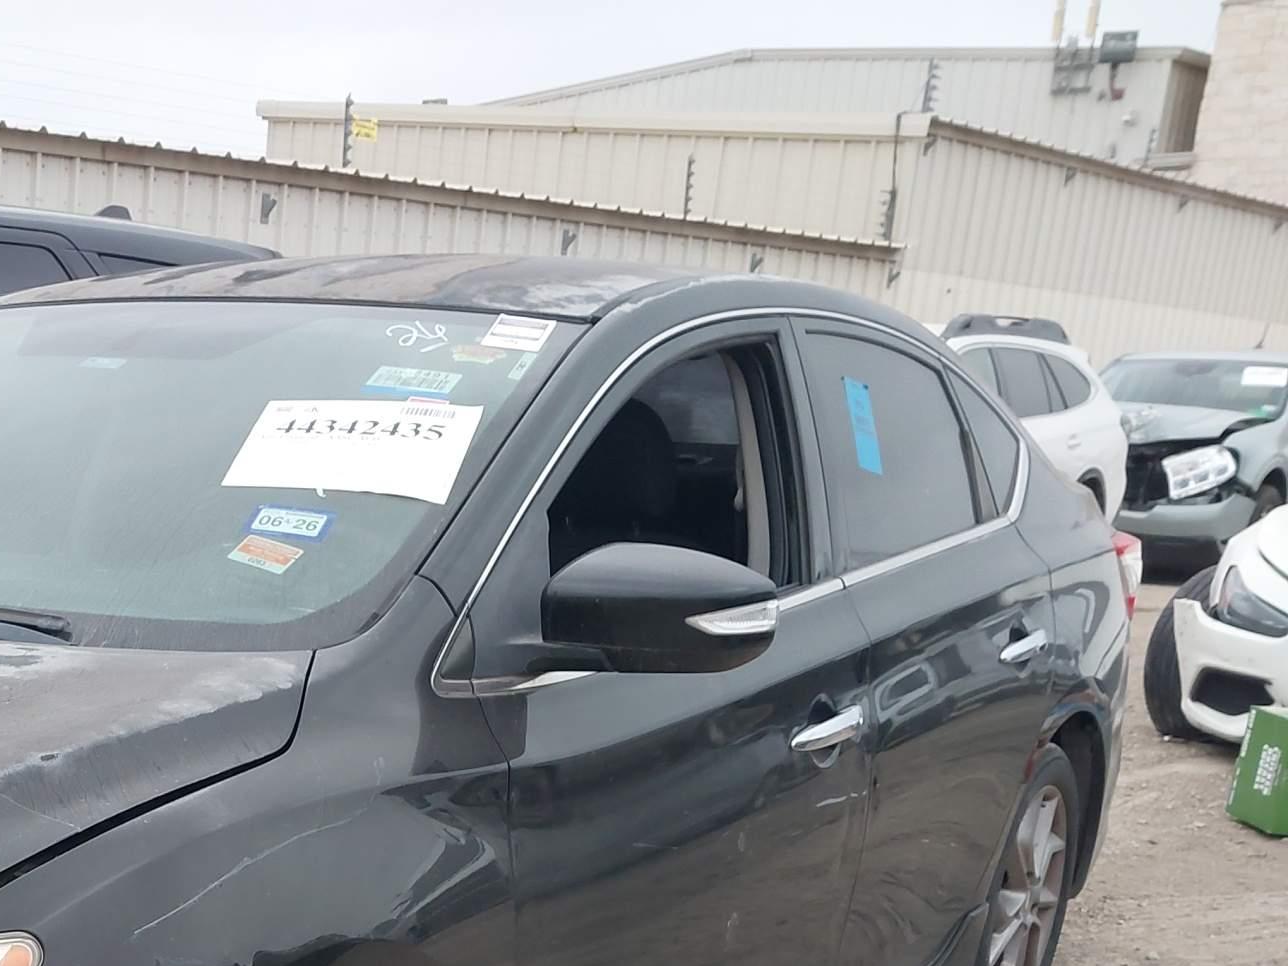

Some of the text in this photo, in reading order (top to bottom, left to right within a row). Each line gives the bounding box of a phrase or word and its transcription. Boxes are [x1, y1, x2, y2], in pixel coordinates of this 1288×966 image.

[276, 419, 446, 440] 44342435
[258, 514, 320, 532] 06 26
